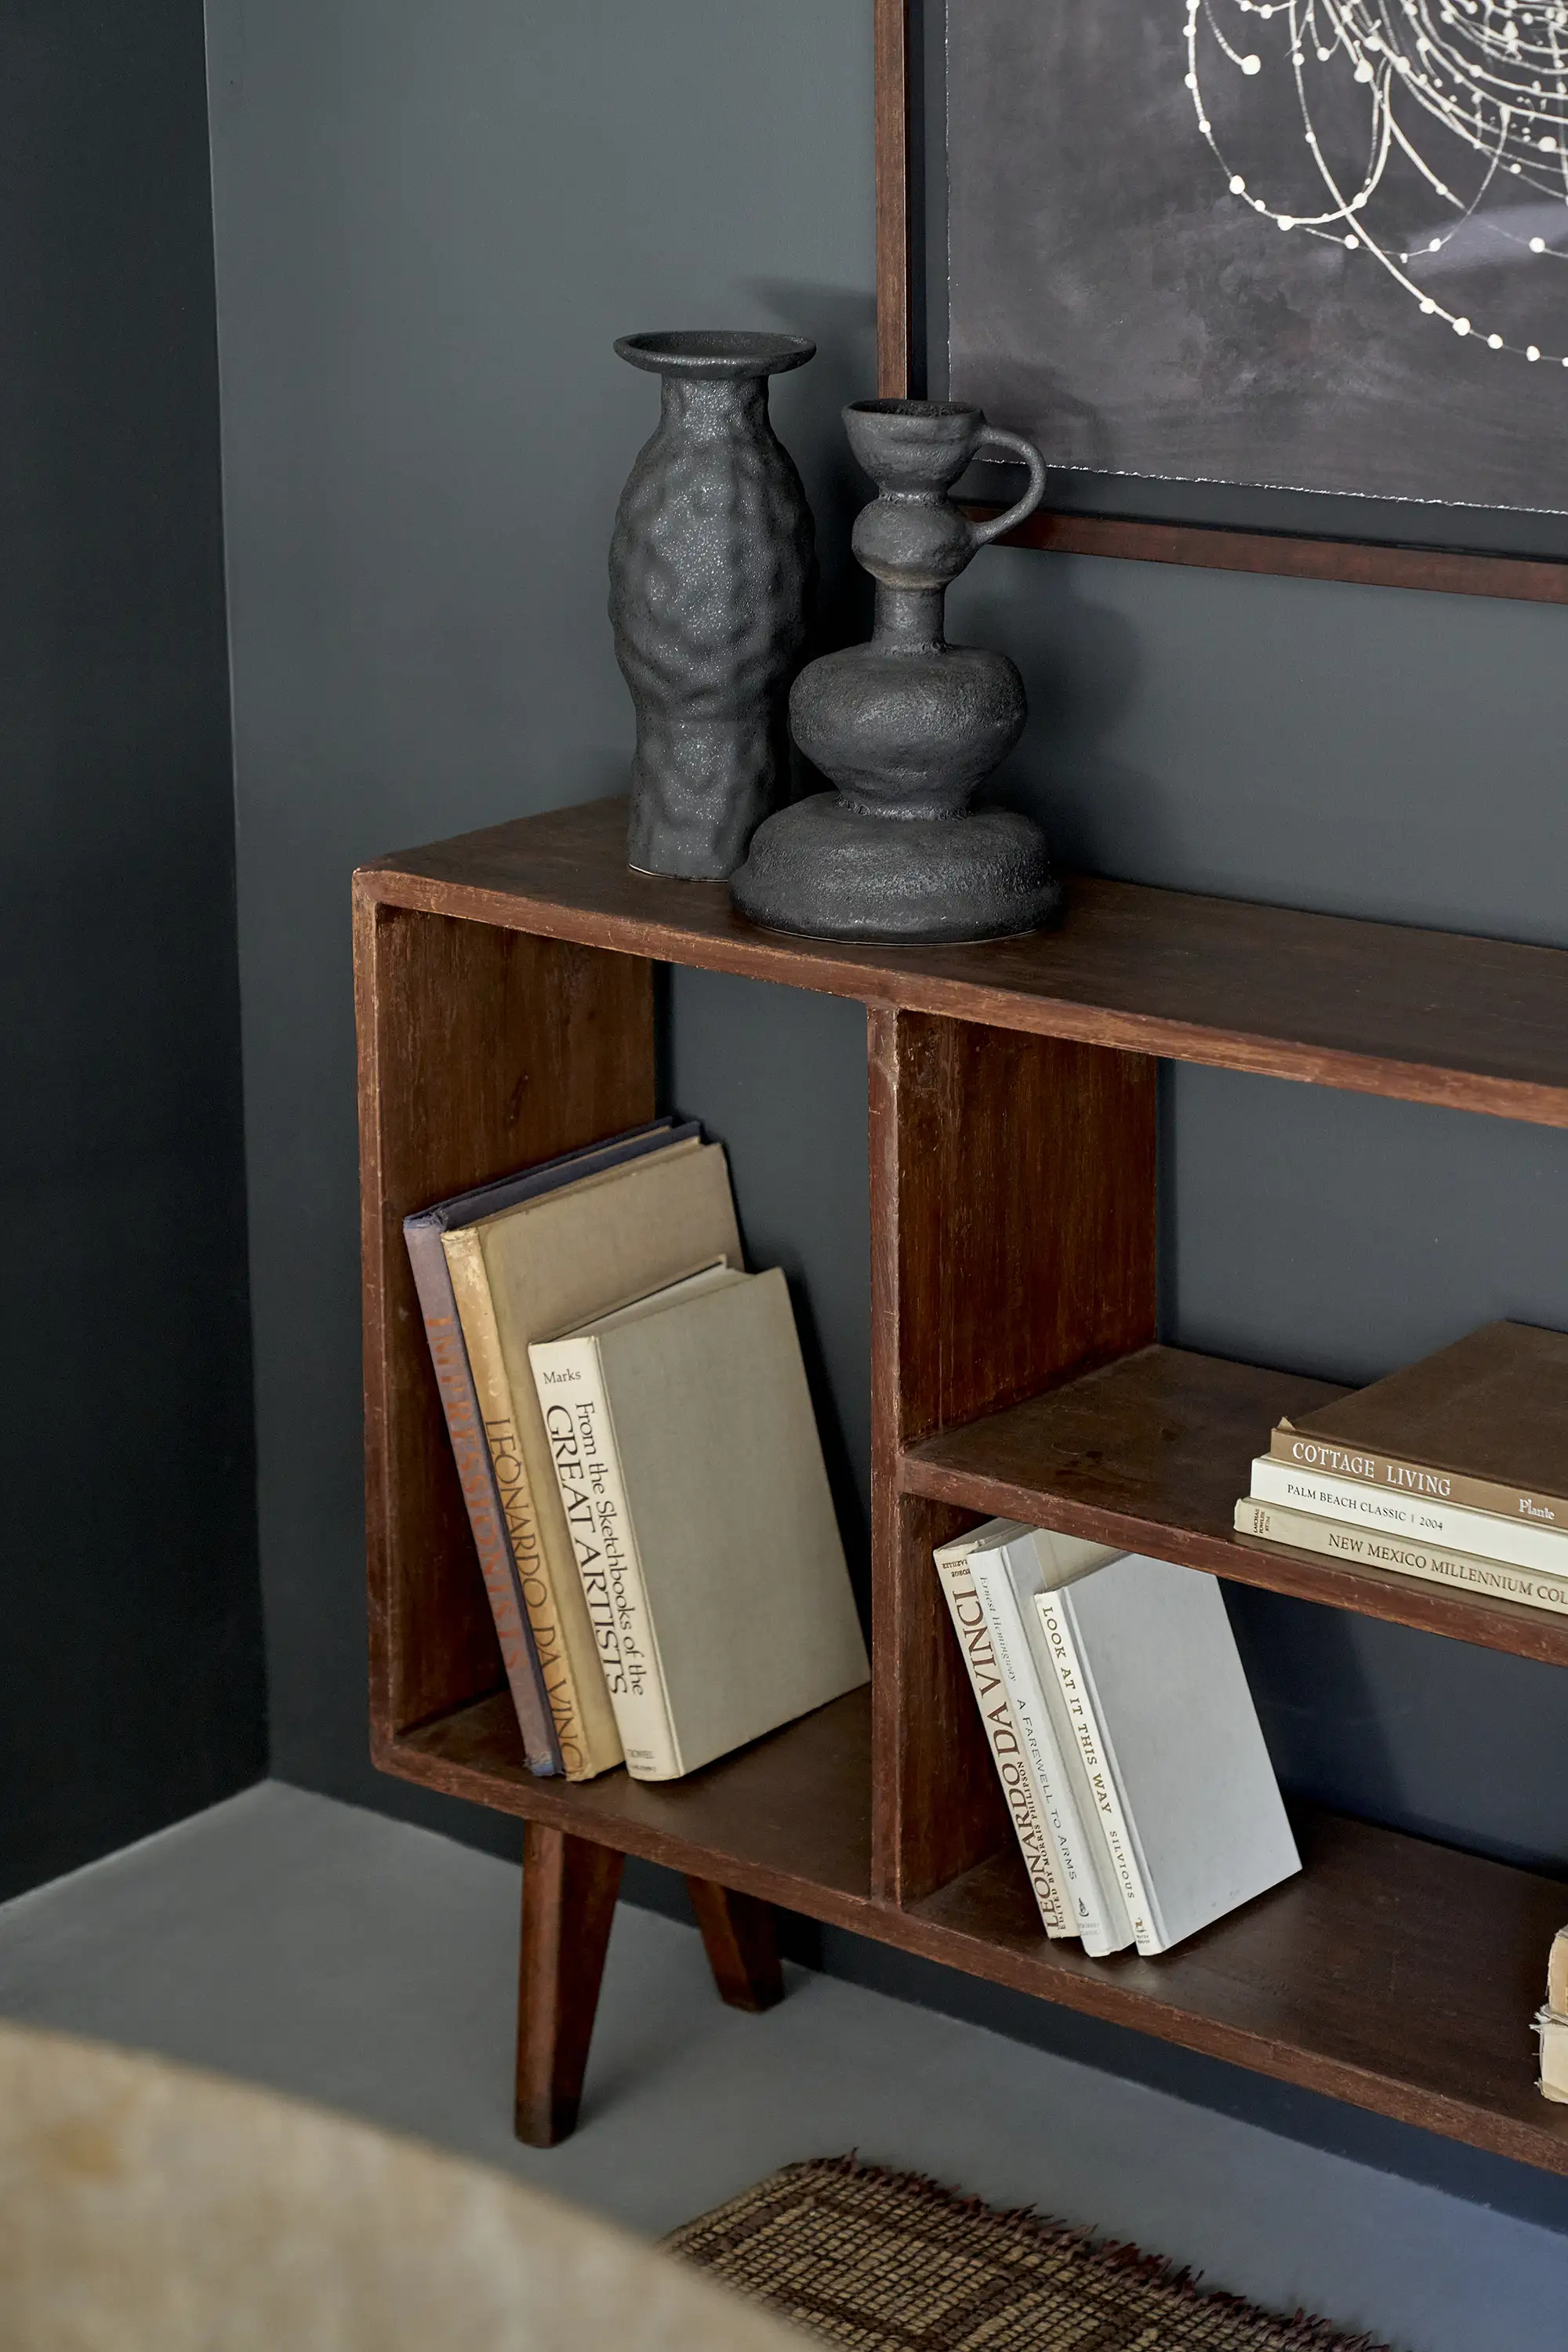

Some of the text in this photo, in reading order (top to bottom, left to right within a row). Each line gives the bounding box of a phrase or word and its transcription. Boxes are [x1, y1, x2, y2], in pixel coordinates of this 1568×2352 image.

[543, 1368, 582, 1385] Marks
[546, 1405, 627, 1695] GREAT ARTISTS
[575, 1401, 646, 1696] From the Sketchbooks of the
[1287, 1484, 1316, 1500] PALM
[1319, 1492, 1357, 1509] BEACH
[1360, 1502, 1406, 1522] CLASSIC
[1420, 1517, 1443, 1530] 2004
[1293, 1442, 1555, 1521] COTTAGE LIVING Plante
[1329, 1534, 1363, 1553] NEW
[1367, 1544, 1427, 1569] MEXICO
[1432, 1559, 1534, 1596] MILLENNIUM
[485, 1417, 584, 1773] LEONARDO DA VINCI
[980, 1577, 1016, 1682] Ernest Hemingway
[953, 1587, 1058, 1931] LEONARDO DA VINCI
[1017, 1699, 1077, 1881] A FAREWELL TO ARMS
[1042, 1606, 1112, 1813] LOOK AT IT THIS WAY
[1017, 1761, 1066, 1930] EDITED BY MORRIS PHILIPSON
[1109, 1831, 1135, 1899] SILVIOUS
